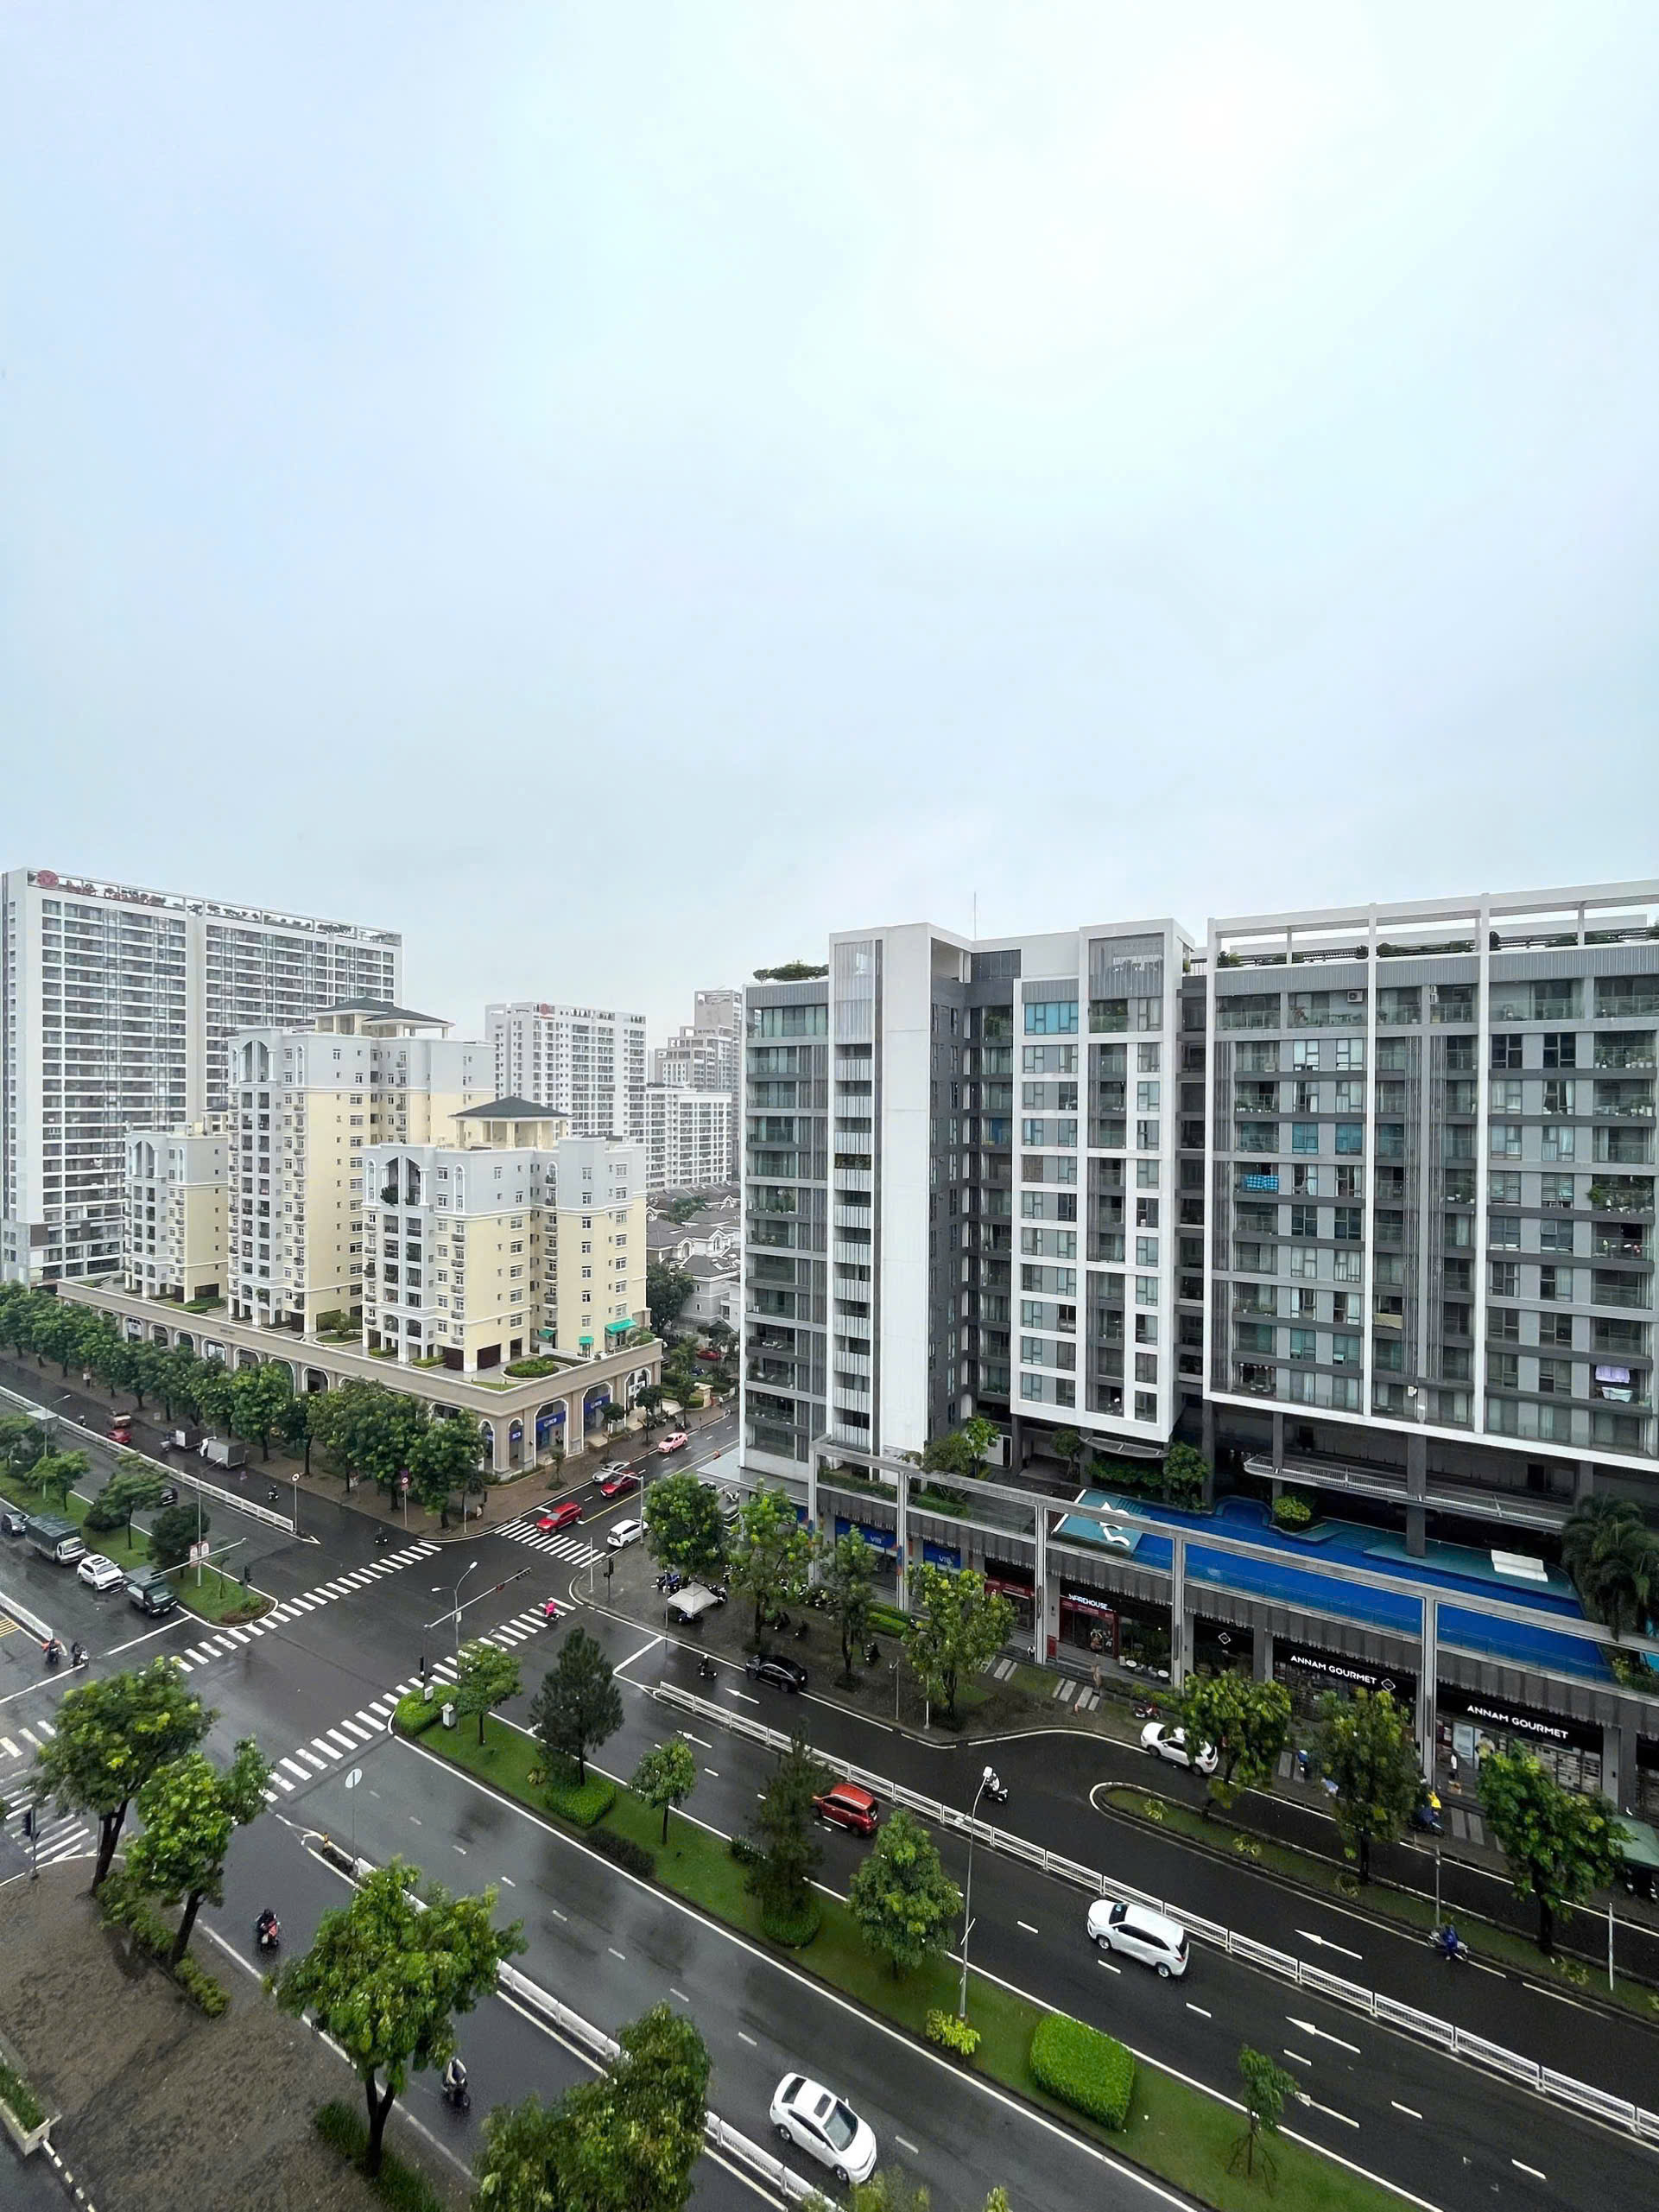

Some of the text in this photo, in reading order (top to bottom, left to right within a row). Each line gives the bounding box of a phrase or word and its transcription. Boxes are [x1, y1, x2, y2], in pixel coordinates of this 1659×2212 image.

[1290, 1655, 1377, 1684] ANNAM GOURMET
[1467, 1705, 1568, 1739] ANNAM GOURMET
